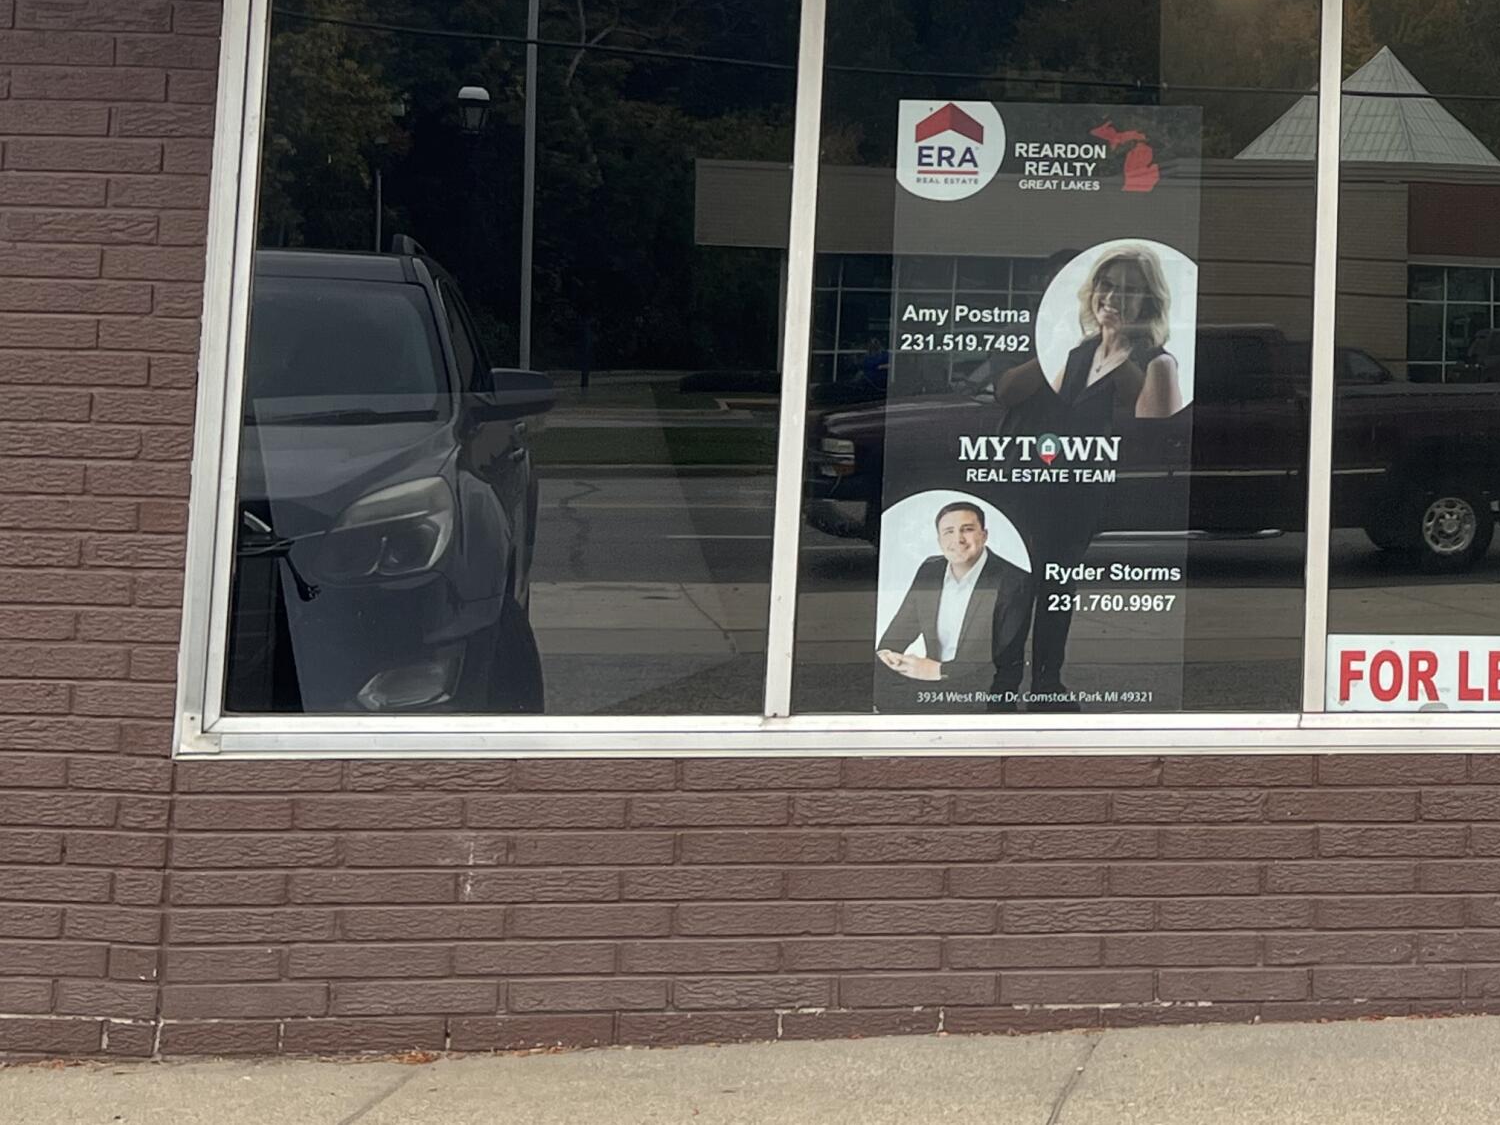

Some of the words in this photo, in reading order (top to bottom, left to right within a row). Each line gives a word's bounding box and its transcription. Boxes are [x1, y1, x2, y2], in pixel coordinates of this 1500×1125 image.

[917, 145, 978, 168] ERA
[1015, 143, 1106, 158] REARDON
[1025, 162, 1097, 176] REALTY
[916, 177, 941, 185] REAL
[944, 177, 979, 185] ESTATE
[1019, 180, 1058, 189] GREAT
[1061, 181, 1100, 190] LAKES
[903, 305, 948, 325] Amy
[955, 306, 1029, 322] Postma
[901, 334, 1029, 351] 231.519.7492
[967, 469, 1007, 481] REAL
[1012, 469, 1068, 482] ESTATE
[1074, 470, 1115, 482] TEAM
[1046, 564, 1105, 584] Ryder
[1110, 564, 1180, 580] Storms
[1049, 595, 1175, 611] 231.760.9967
[1340, 650, 1439, 701] FOR
[918, 692, 943, 702] 3934
[946, 692, 972, 702] West
[975, 692, 1002, 702] River
[1005, 692, 1020, 702] Dr.
[1023, 691, 1076, 702] Comstock
[1079, 692, 1102, 701] Park
[1105, 692, 1117, 701] MI
[1121, 692, 1152, 702] 49321
